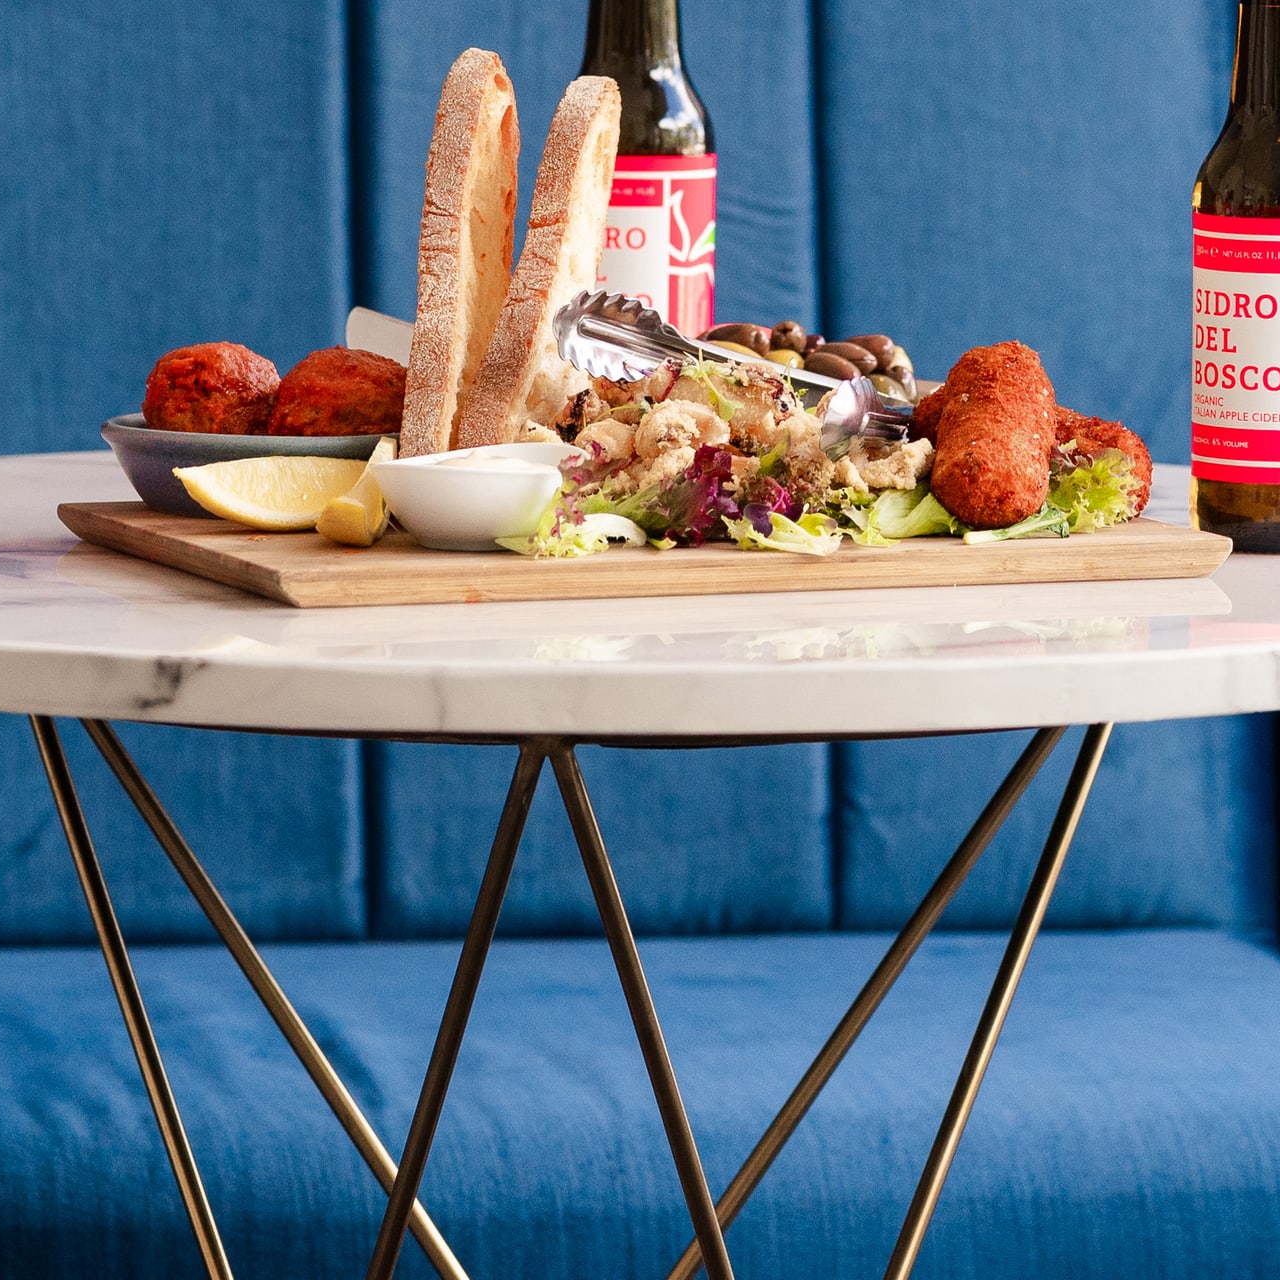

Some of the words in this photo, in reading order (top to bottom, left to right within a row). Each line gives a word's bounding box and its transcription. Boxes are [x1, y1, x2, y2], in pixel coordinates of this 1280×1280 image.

[1222, 250, 1233, 258] NET
[1195, 288, 1278, 319] SIDRO
[1195, 324, 1237, 353] DEL
[1219, 412, 1249, 422] APPLE
[1222, 440, 1249, 449] VOLUME
